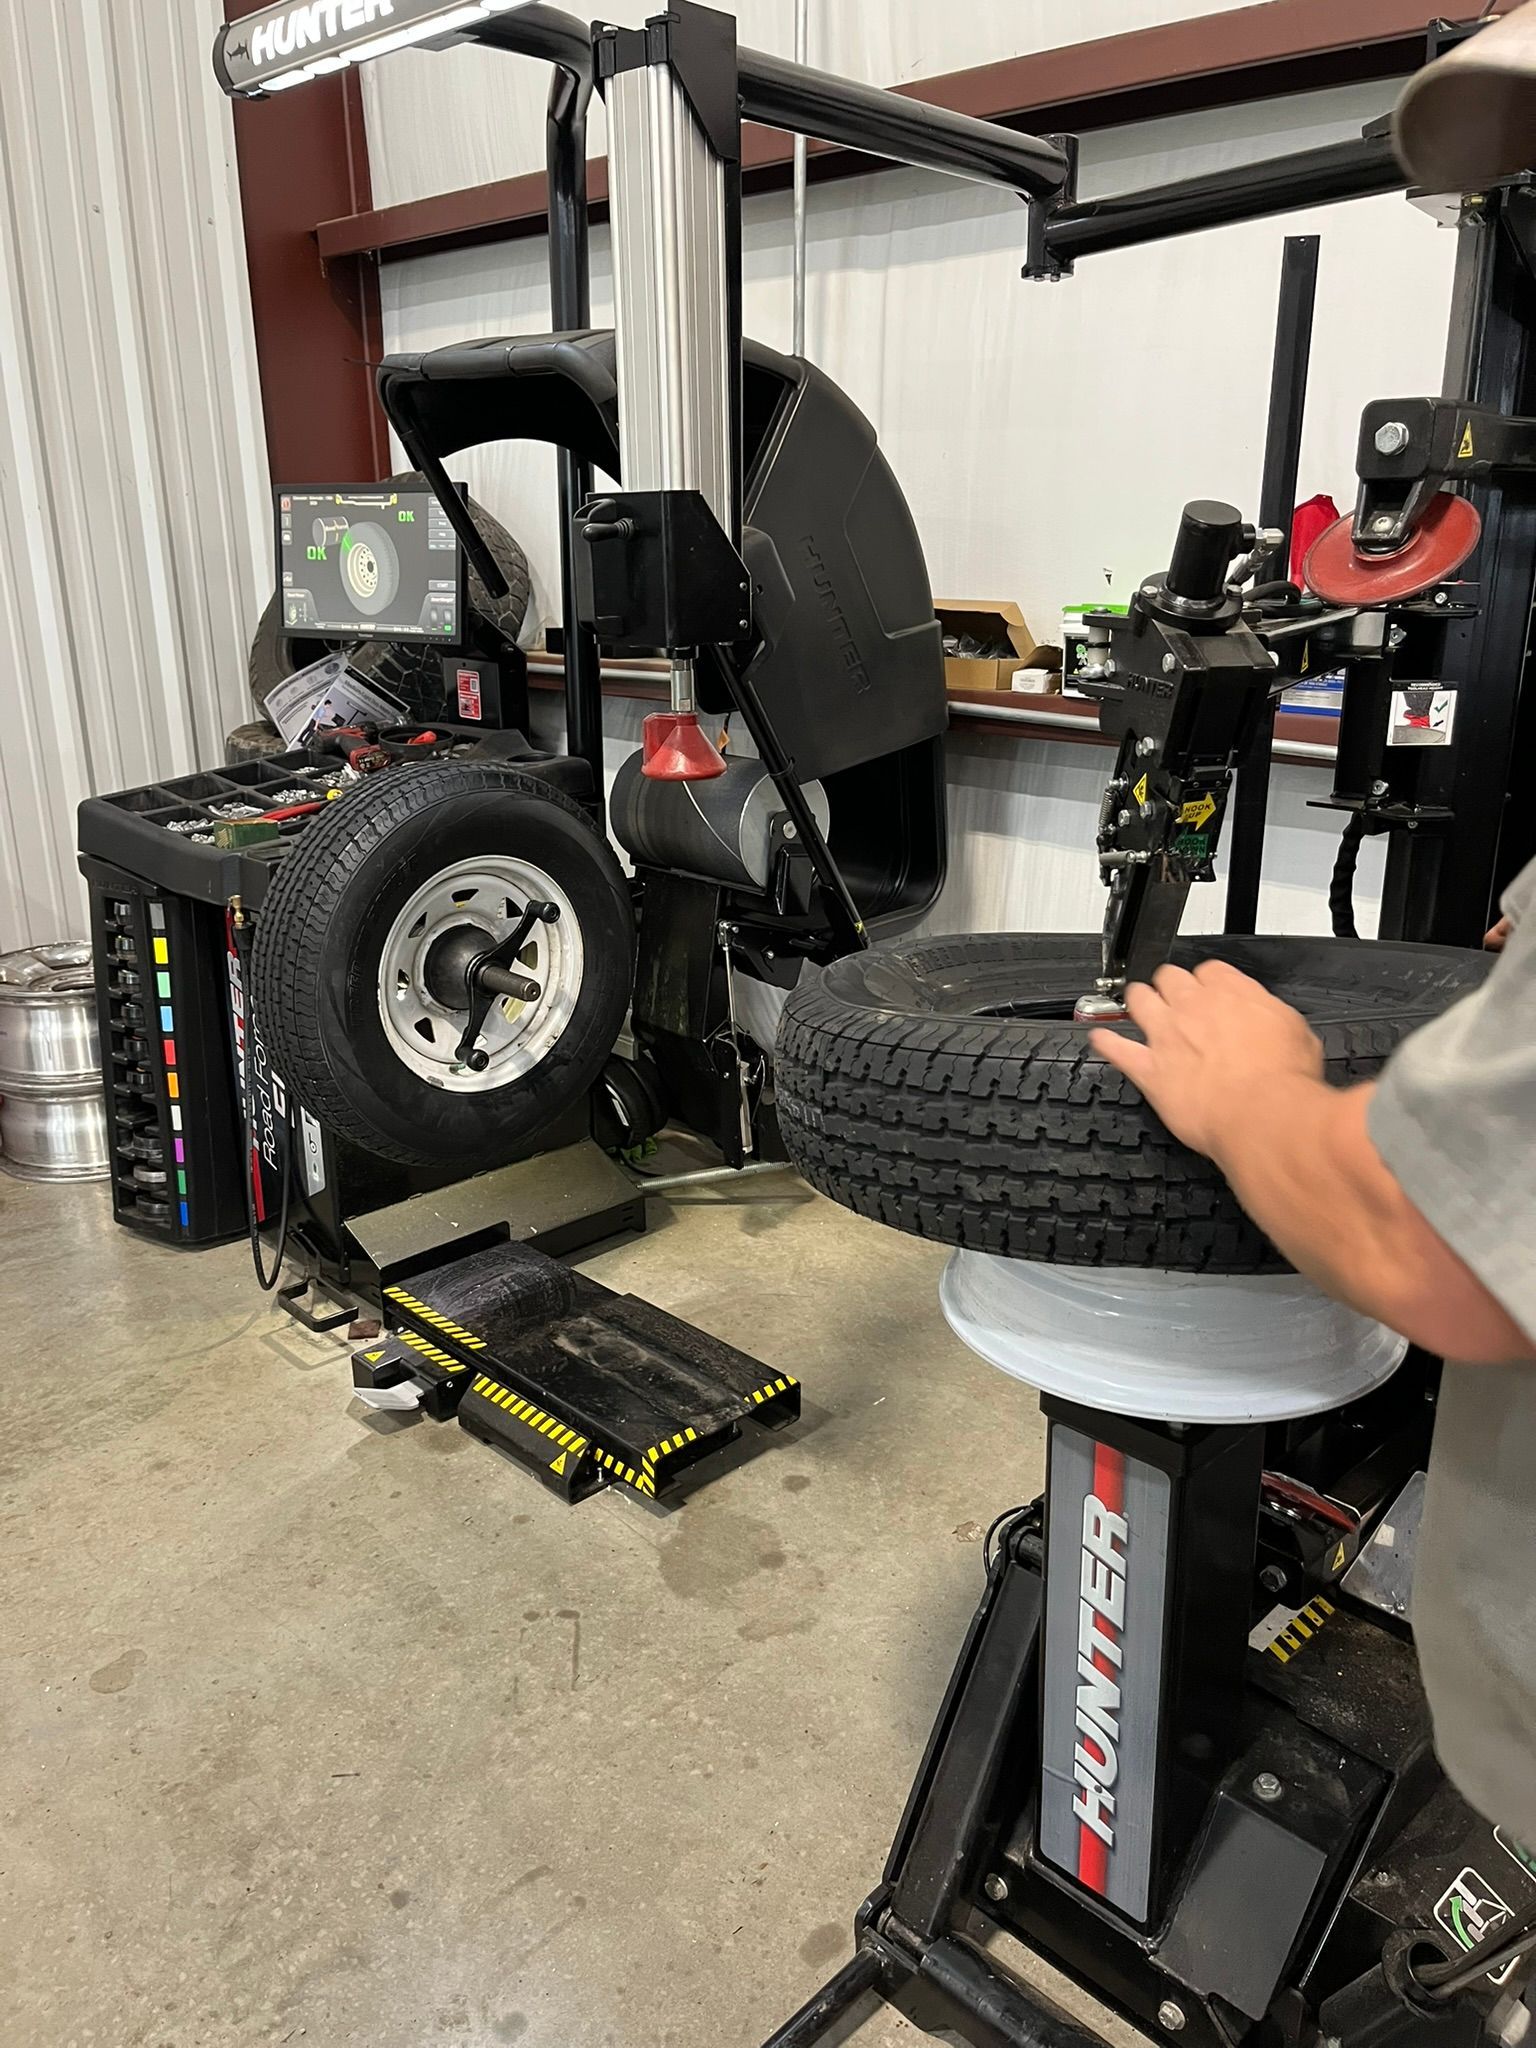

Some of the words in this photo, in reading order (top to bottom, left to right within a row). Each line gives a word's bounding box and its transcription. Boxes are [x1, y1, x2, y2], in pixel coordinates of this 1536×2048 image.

[398, 510, 415, 522] OK
[306, 546, 327, 560] OK
[799, 534, 872, 695] HUNTER
[1184, 804, 1211, 814] HOOK
[256, 1085, 278, 1171] Road
[1071, 1493, 1129, 1848] HUNTER
